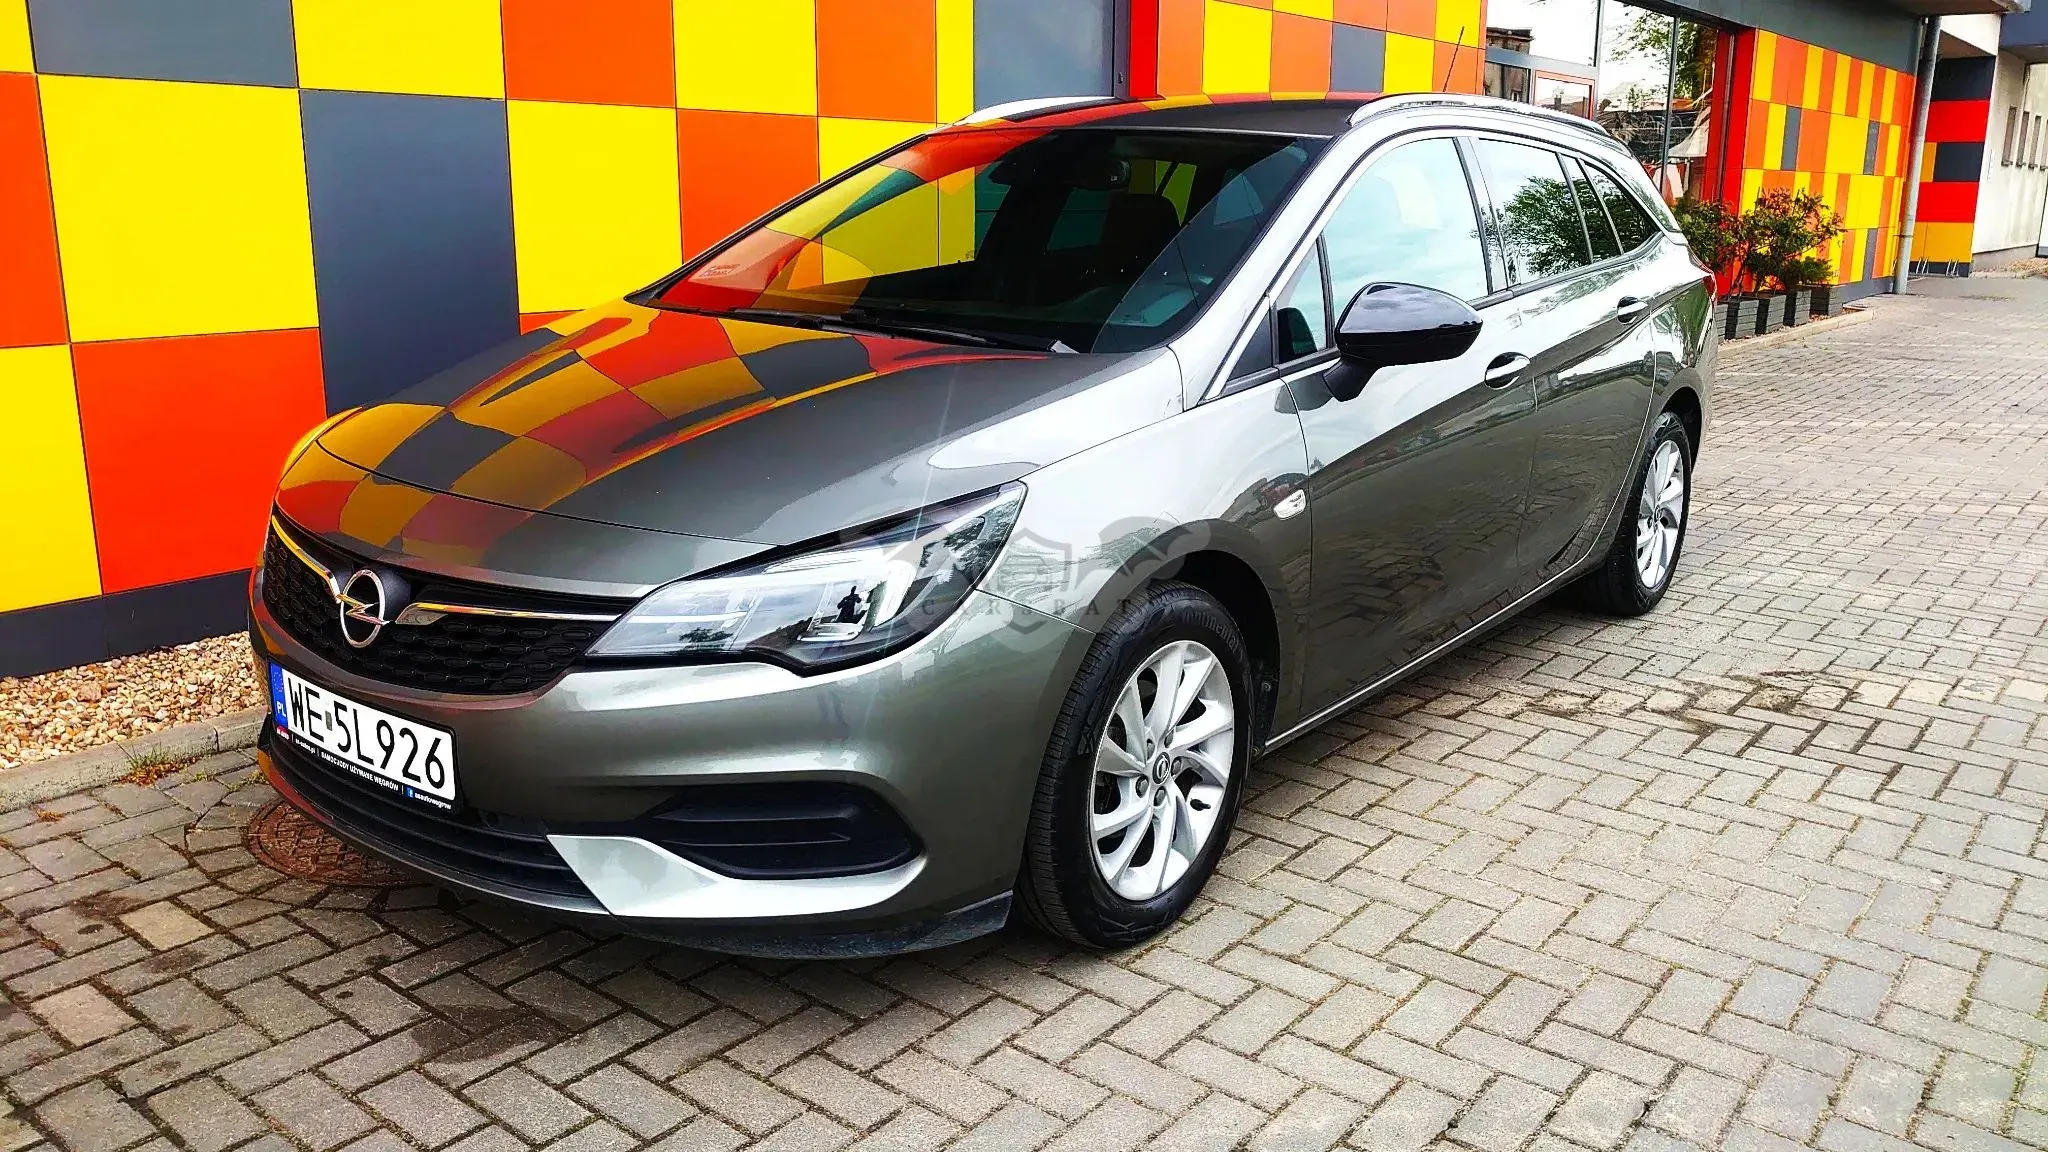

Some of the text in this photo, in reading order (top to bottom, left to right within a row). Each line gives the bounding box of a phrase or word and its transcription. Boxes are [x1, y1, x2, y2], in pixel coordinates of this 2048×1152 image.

[276, 701, 287, 718] PL
[288, 677, 446, 790] WE 5L926
